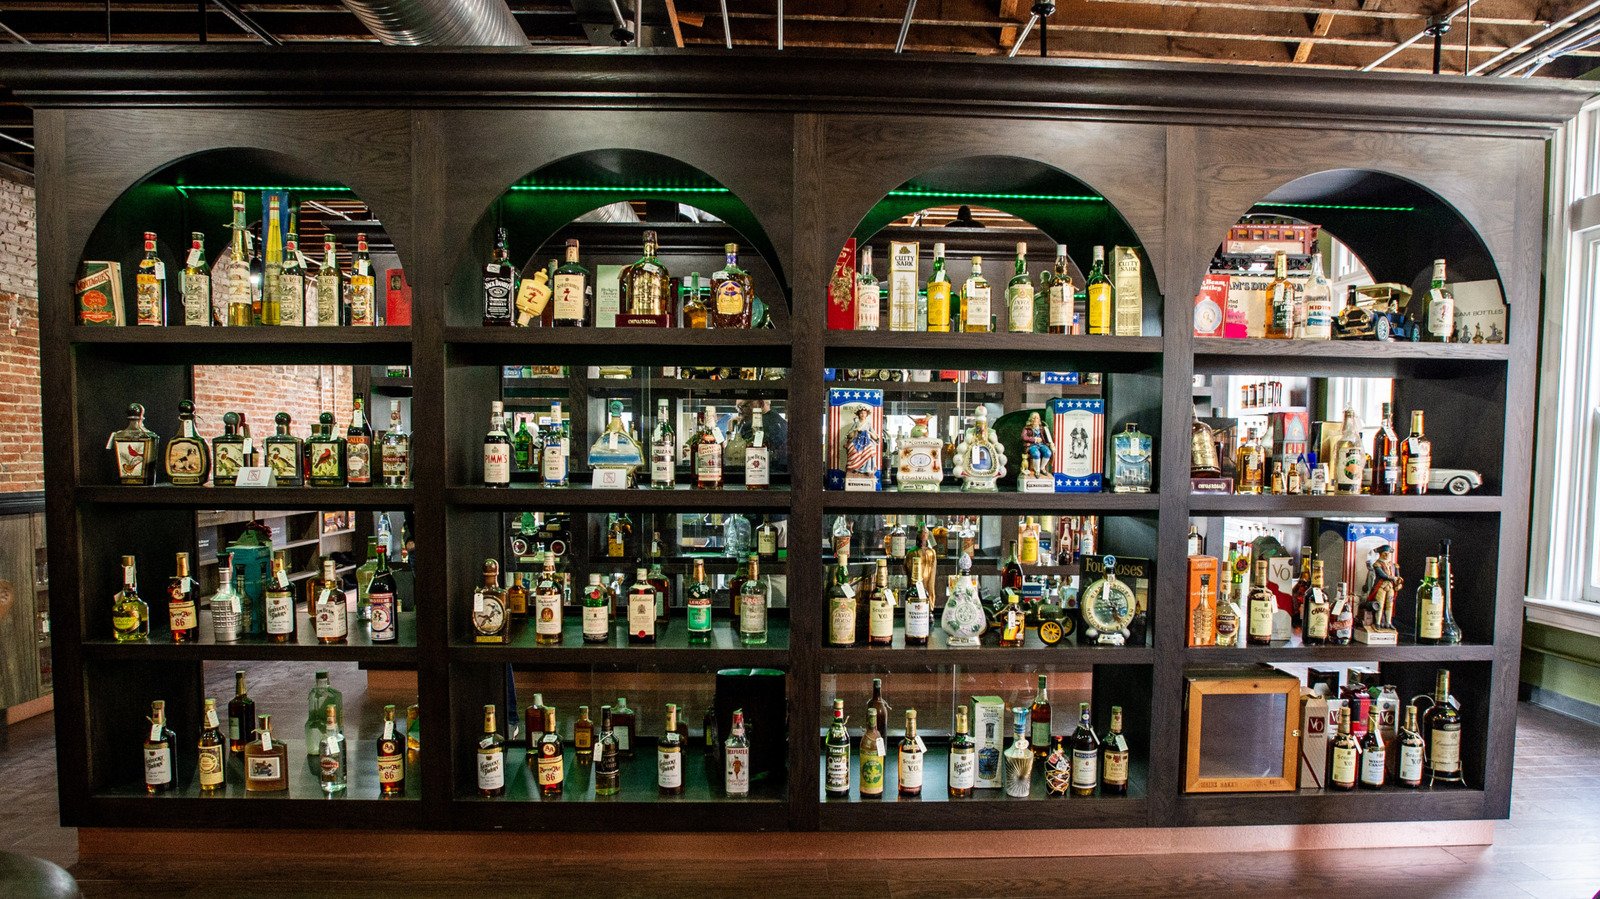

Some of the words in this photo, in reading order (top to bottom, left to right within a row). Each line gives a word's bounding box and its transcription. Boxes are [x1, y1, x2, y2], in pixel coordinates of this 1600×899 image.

[484, 282, 496, 290] JACK
[527, 292, 537, 304] 7
[563, 288, 571, 302] 7
[1472, 308, 1503, 316] BOTTLES
[485, 453, 507, 464] PIMM'S
[1085, 558, 1105, 573] Fou
[1114, 562, 1144, 577] oses
[1273, 564, 1290, 581] VO
[175, 618, 185, 627] 86
[1381, 712, 1395, 725] VO
[1310, 719, 1324, 731] VO
[384, 772, 394, 780] 86
[545, 773, 555, 781] 86
